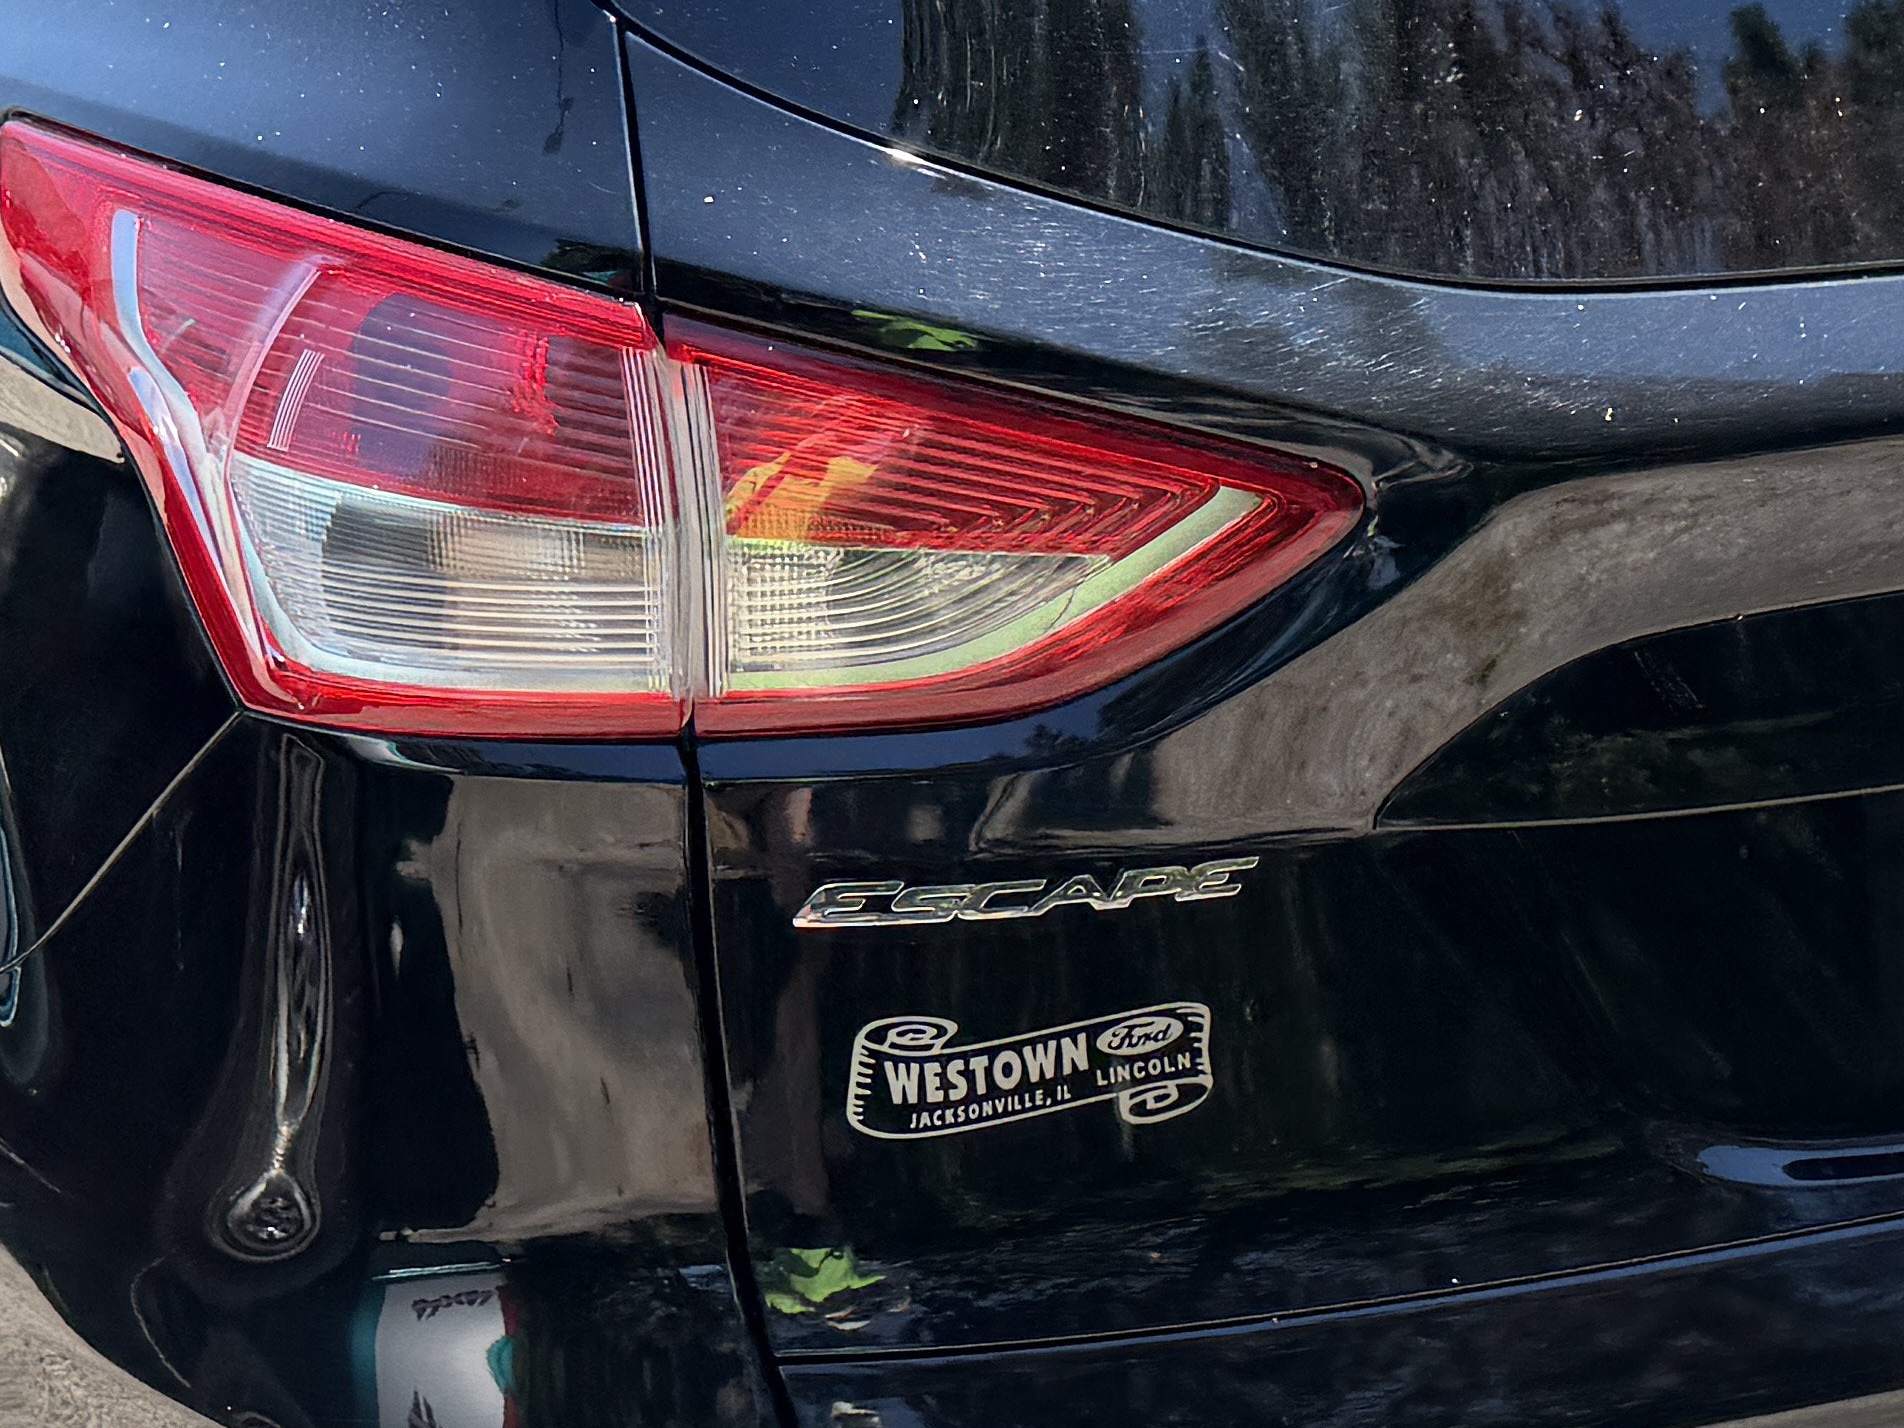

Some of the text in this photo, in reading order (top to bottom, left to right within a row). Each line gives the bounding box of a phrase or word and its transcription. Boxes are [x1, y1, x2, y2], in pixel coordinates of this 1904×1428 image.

[793, 856, 1260, 927] ESCAPE
[1108, 1021, 1171, 1050] Ford
[884, 1032, 1089, 1104] WESTOWN
[1096, 1052, 1192, 1086] LINCOLN
[910, 1085, 1072, 1129] JACKSONVILLE, IL
